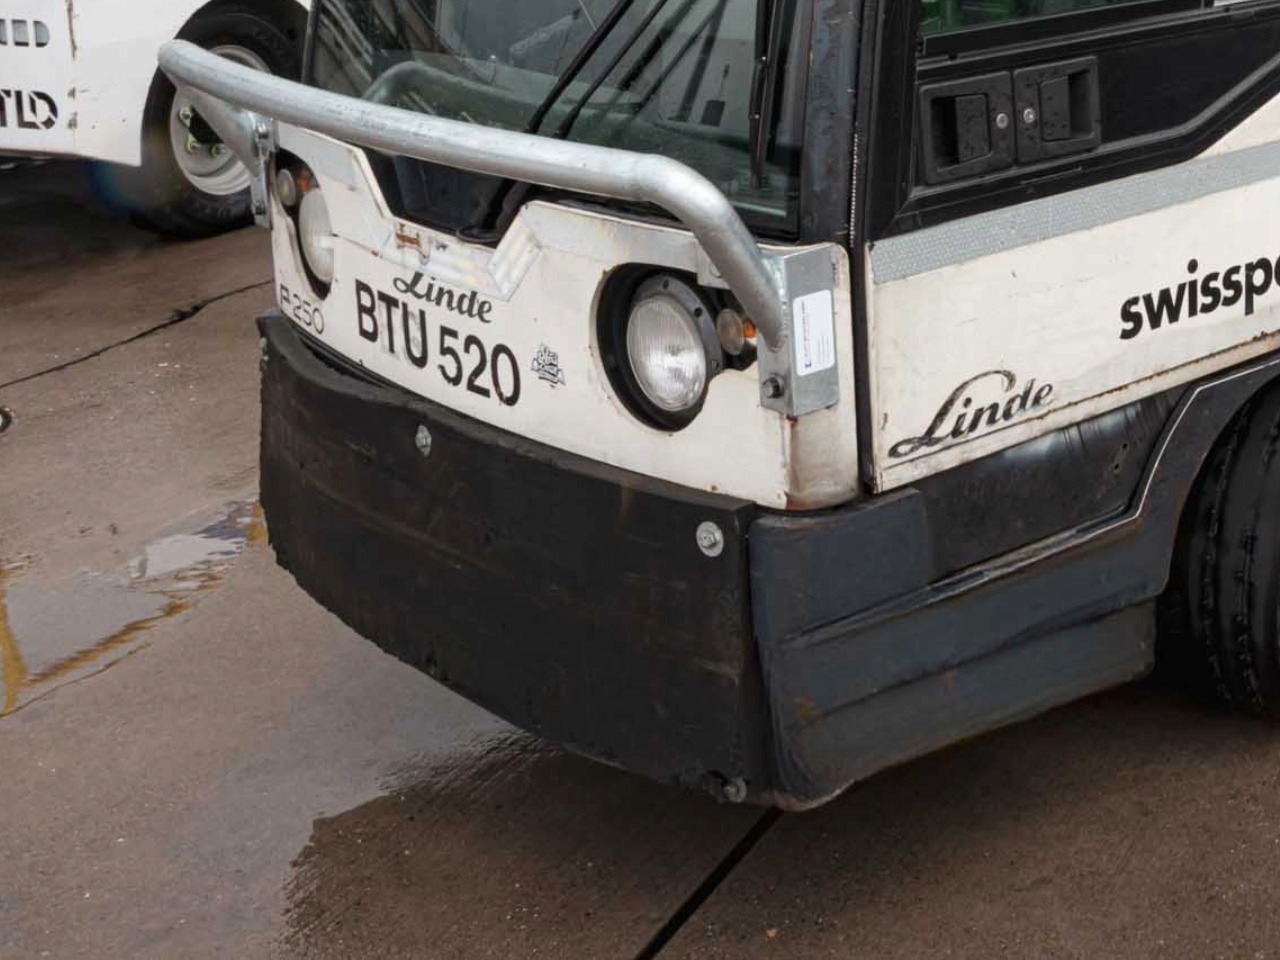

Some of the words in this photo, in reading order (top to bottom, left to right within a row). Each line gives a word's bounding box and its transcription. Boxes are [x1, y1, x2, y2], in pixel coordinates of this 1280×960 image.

[393, 271, 493, 323] Linde
[355, 279, 428, 369] BTU
[437, 325, 521, 406] 520
[888, 369, 1054, 458] Linde
